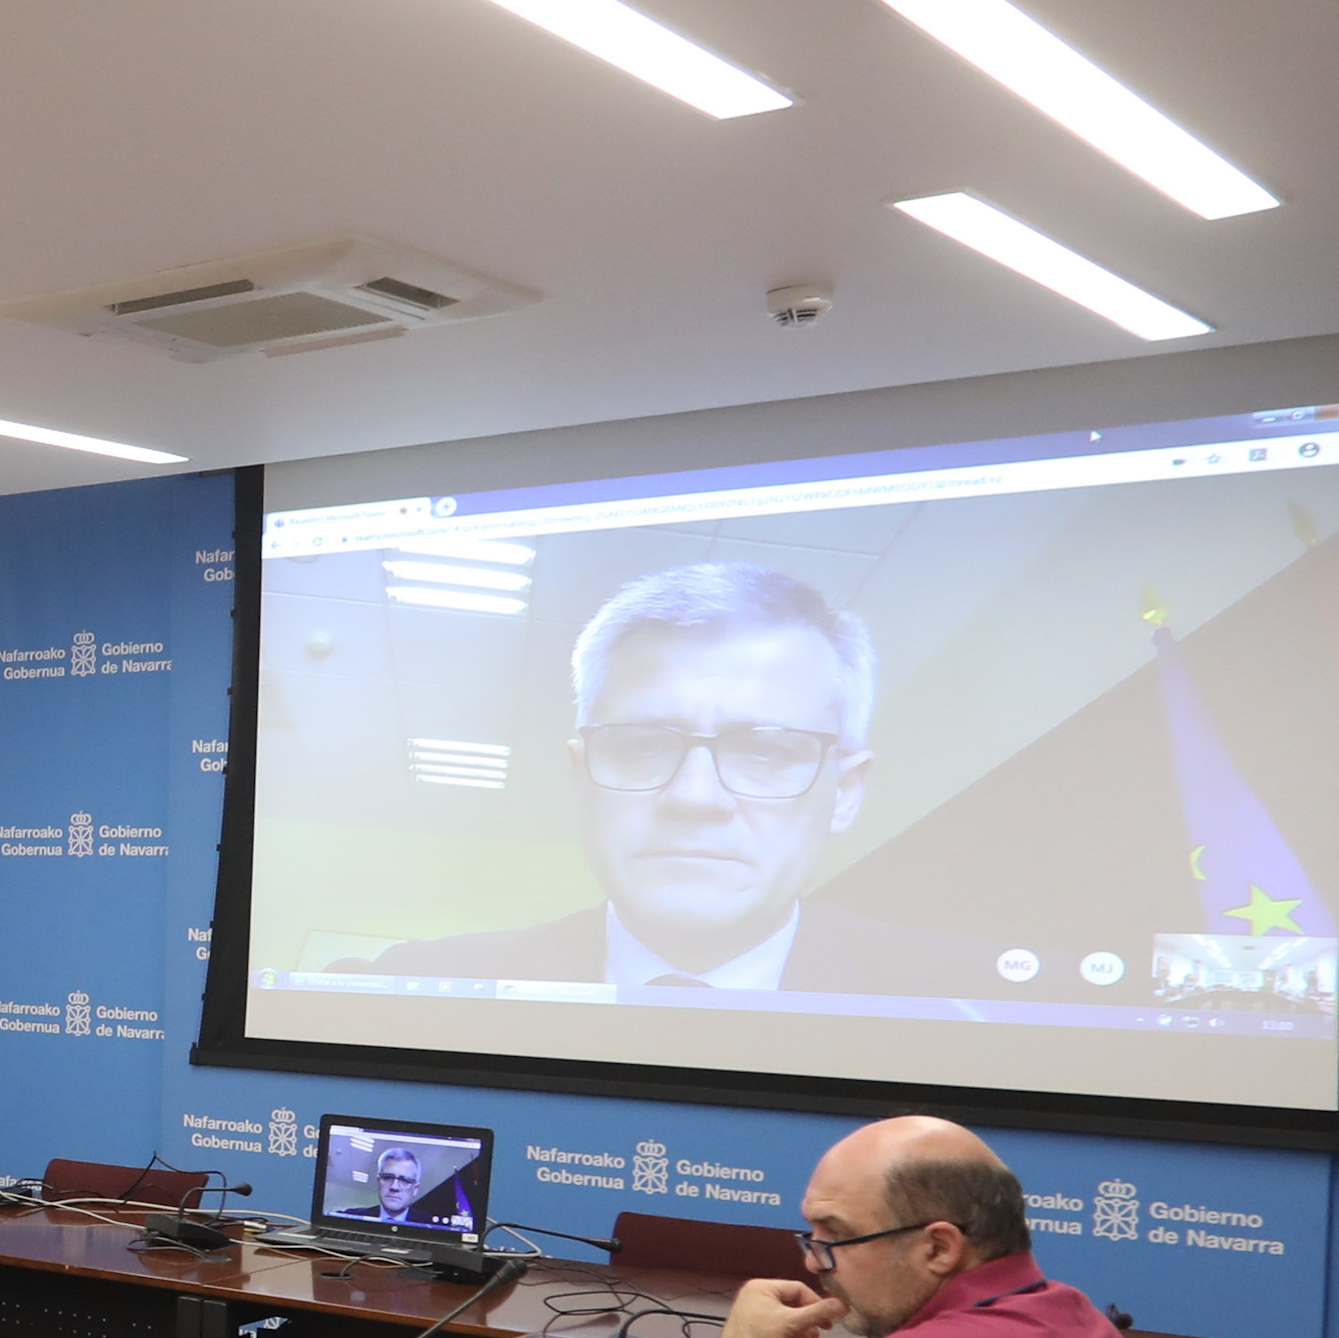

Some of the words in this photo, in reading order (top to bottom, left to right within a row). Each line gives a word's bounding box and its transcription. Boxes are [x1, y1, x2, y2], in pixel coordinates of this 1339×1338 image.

[203, 567, 235, 582] Gob
[101, 641, 164, 656] Gobierno
[3, 666, 65, 680] Gobernua
[101, 661, 118, 674] de
[98, 825, 162, 838] Gobierno
[1, 843, 63, 856] Gobernua
[98, 843, 116, 856] de
[96, 1005, 158, 1022] Gobierno
[96, 1024, 114, 1037] de
[183, 1114, 263, 1134] Nafarroako
[191, 1133, 262, 1153] Gobernua
[526, 1145, 625, 1169] Nafarroako
[536, 1166, 625, 1190] Gobernua
[676, 1159, 764, 1182] Gobierno
[675, 1181, 699, 1198] de
[705, 1183, 781, 1206] Navarra
[1149, 1201, 1263, 1228] Gobierno
[1148, 1226, 1179, 1245] de
[1186, 1229, 1284, 1255] Navarra
